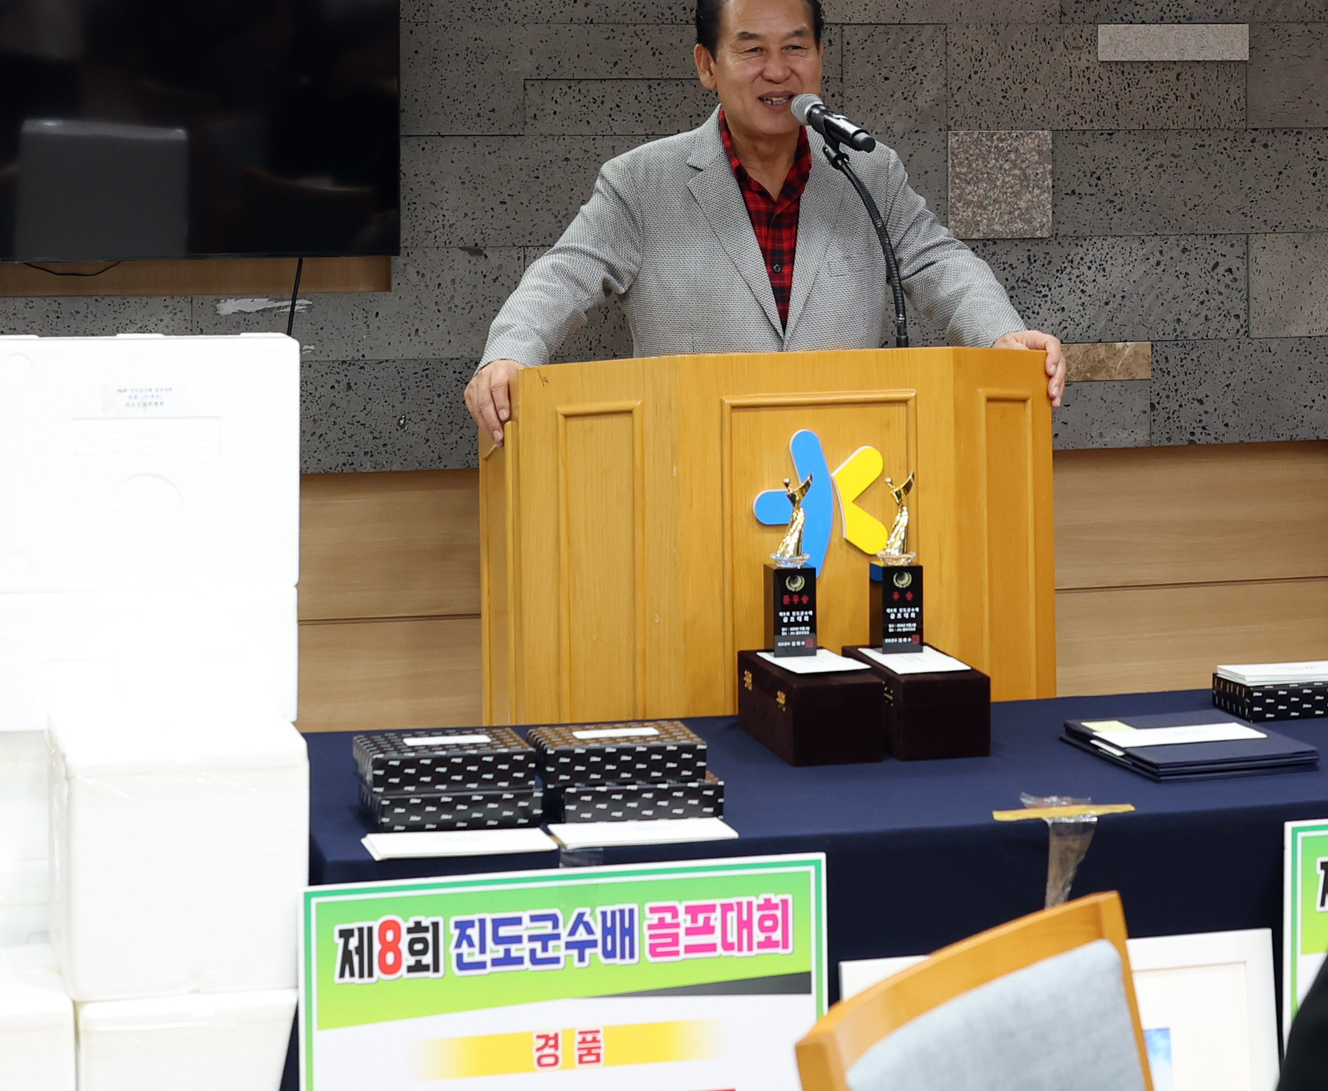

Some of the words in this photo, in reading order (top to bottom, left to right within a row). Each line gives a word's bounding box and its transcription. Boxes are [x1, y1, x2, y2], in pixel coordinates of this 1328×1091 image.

[339, 919, 440, 978] 제8회
[455, 909, 635, 971] 진도군수배
[648, 898, 790, 958] 골프대회
